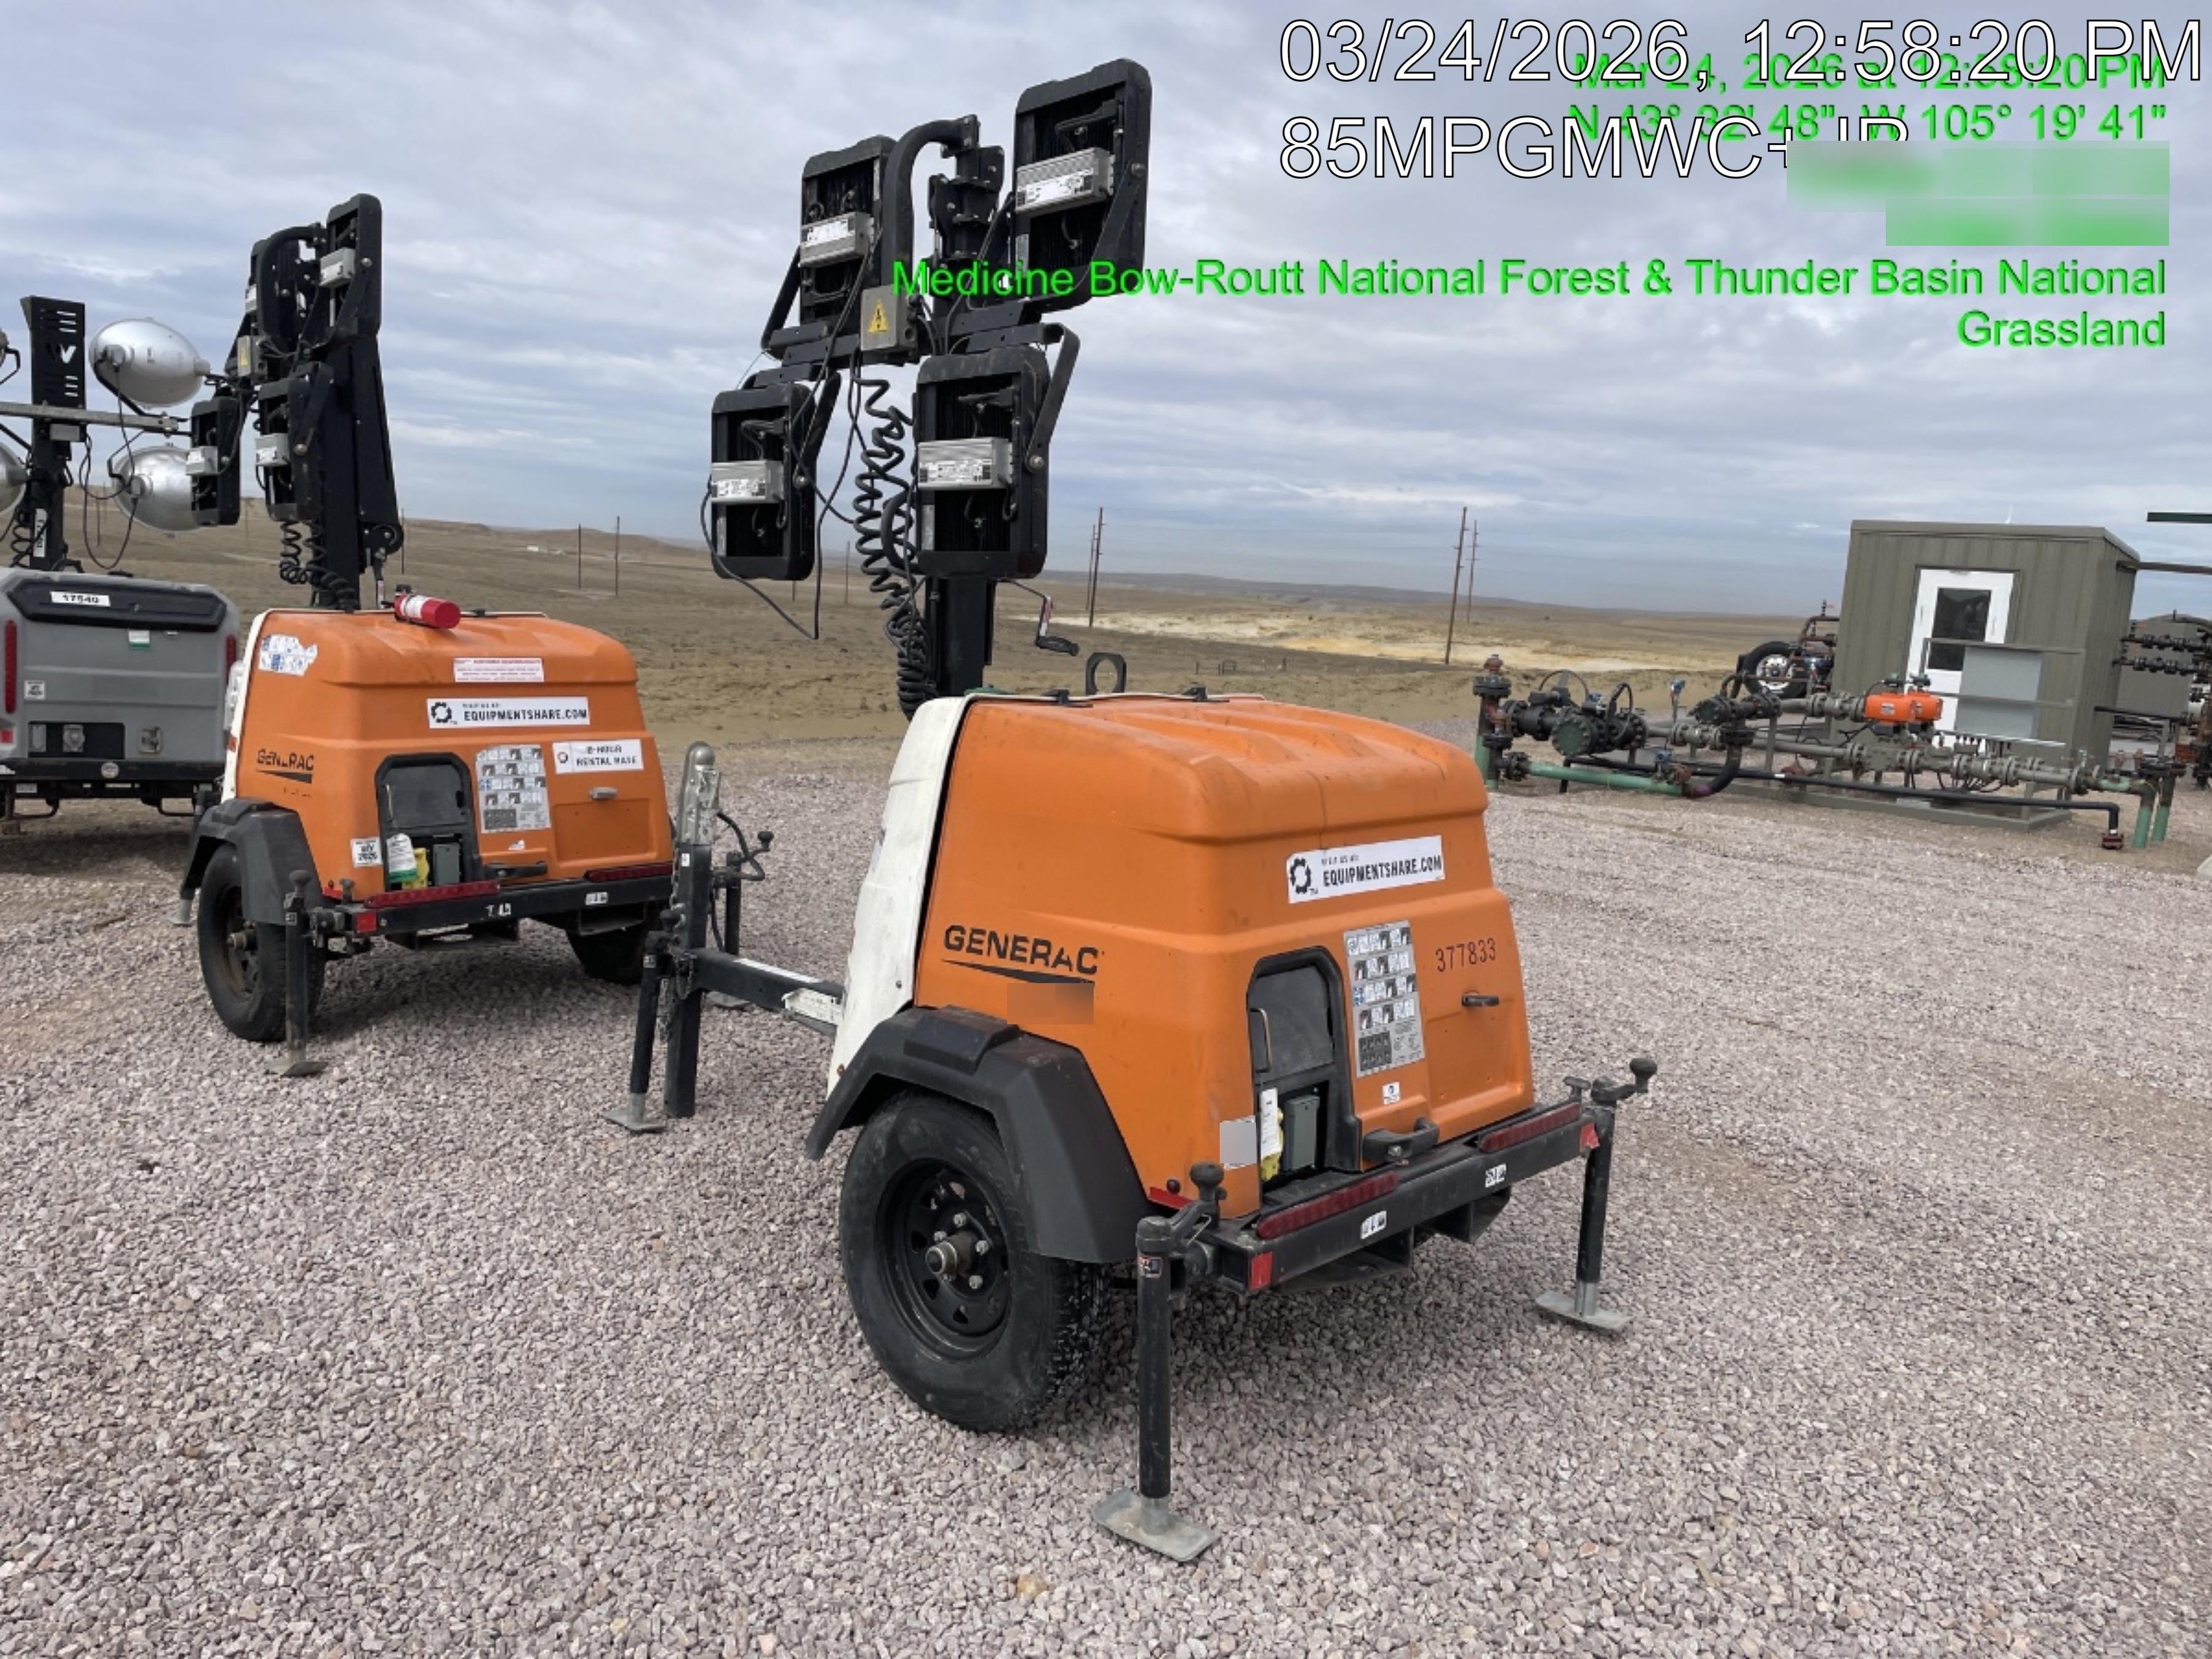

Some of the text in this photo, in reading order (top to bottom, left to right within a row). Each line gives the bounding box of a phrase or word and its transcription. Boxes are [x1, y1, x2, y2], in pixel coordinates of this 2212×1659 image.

[464, 708, 587, 721] EQUIPMENTSHARE.COM
[1324, 855, 1442, 887] EQUIPMENTSHARE.COM
[944, 924, 1098, 975] GENERAC
[1435, 937, 1496, 972] 377833
